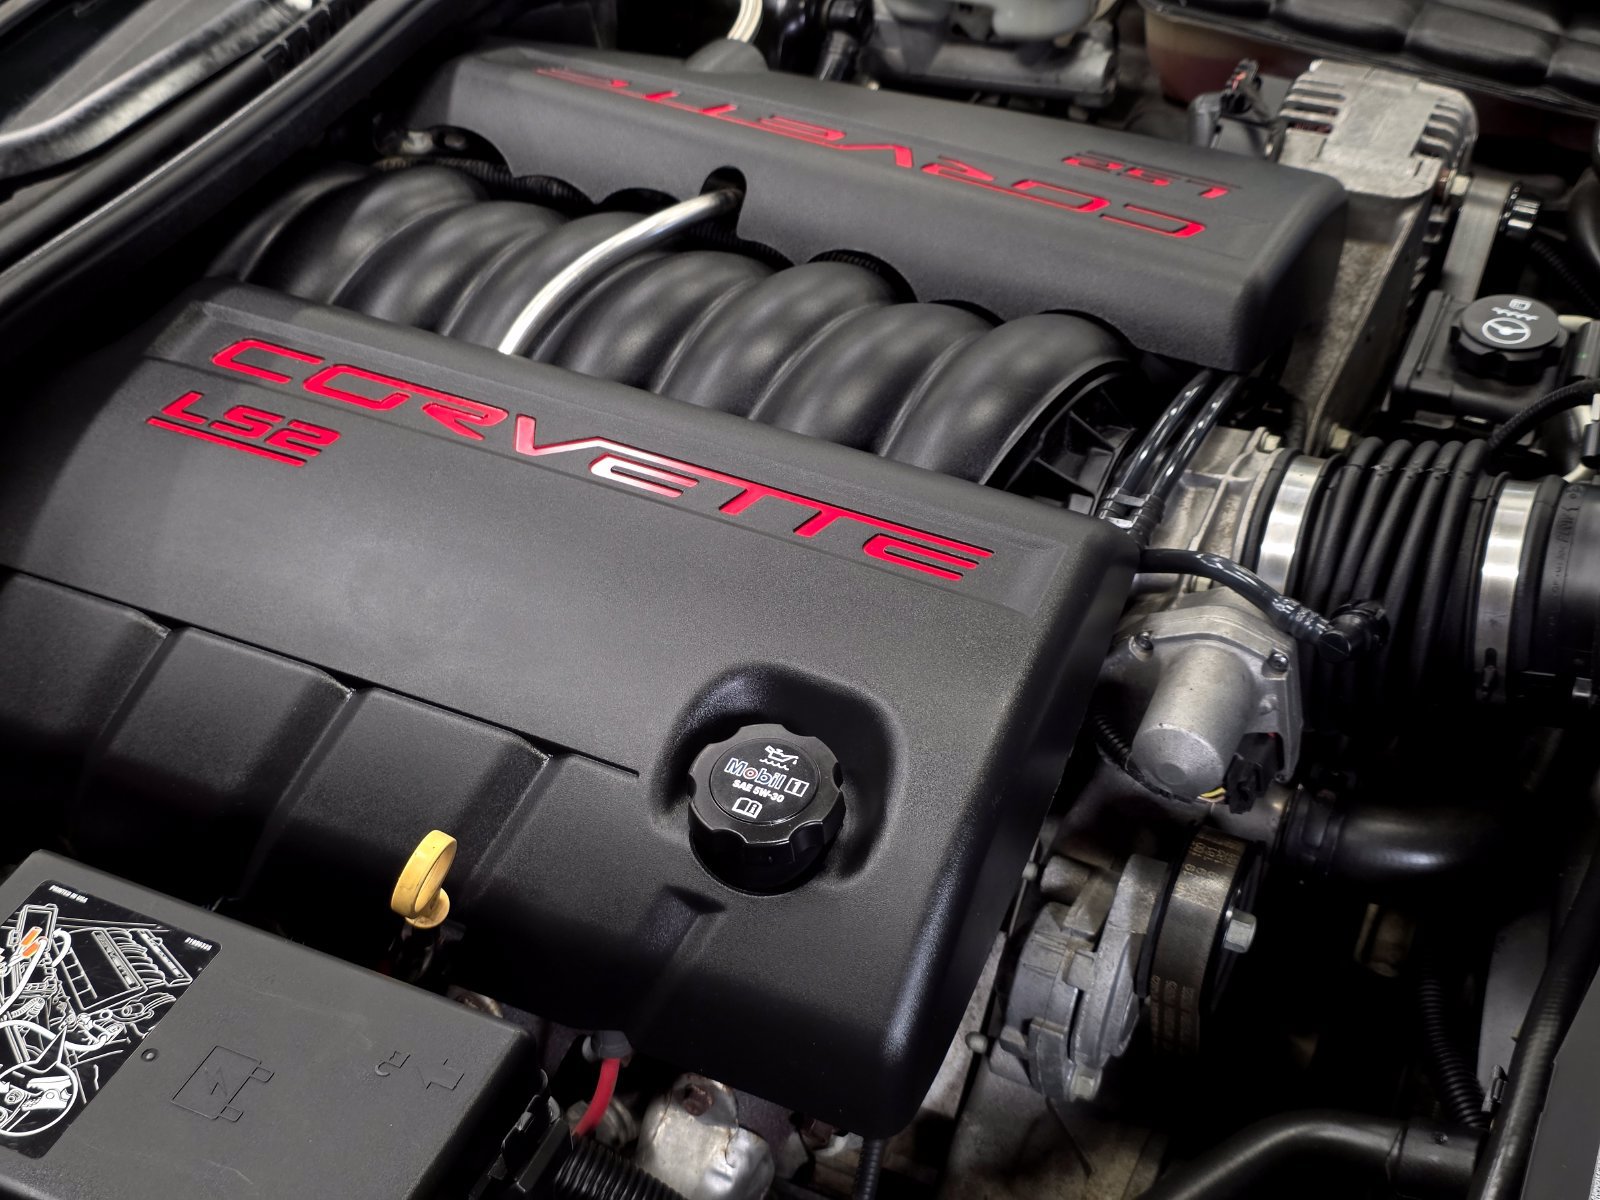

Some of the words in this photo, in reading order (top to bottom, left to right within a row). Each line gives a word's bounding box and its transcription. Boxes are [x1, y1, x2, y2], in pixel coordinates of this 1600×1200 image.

[533, 67, 1206, 238] CORVETTE
[1062, 153, 1234, 199] LS2
[160, 390, 341, 457] LS2
[210, 337, 994, 582] CORVETTE
[723, 757, 787, 790] Mobil
[732, 779, 754, 793] SAE
[752, 786, 785, 803] 5W-30
